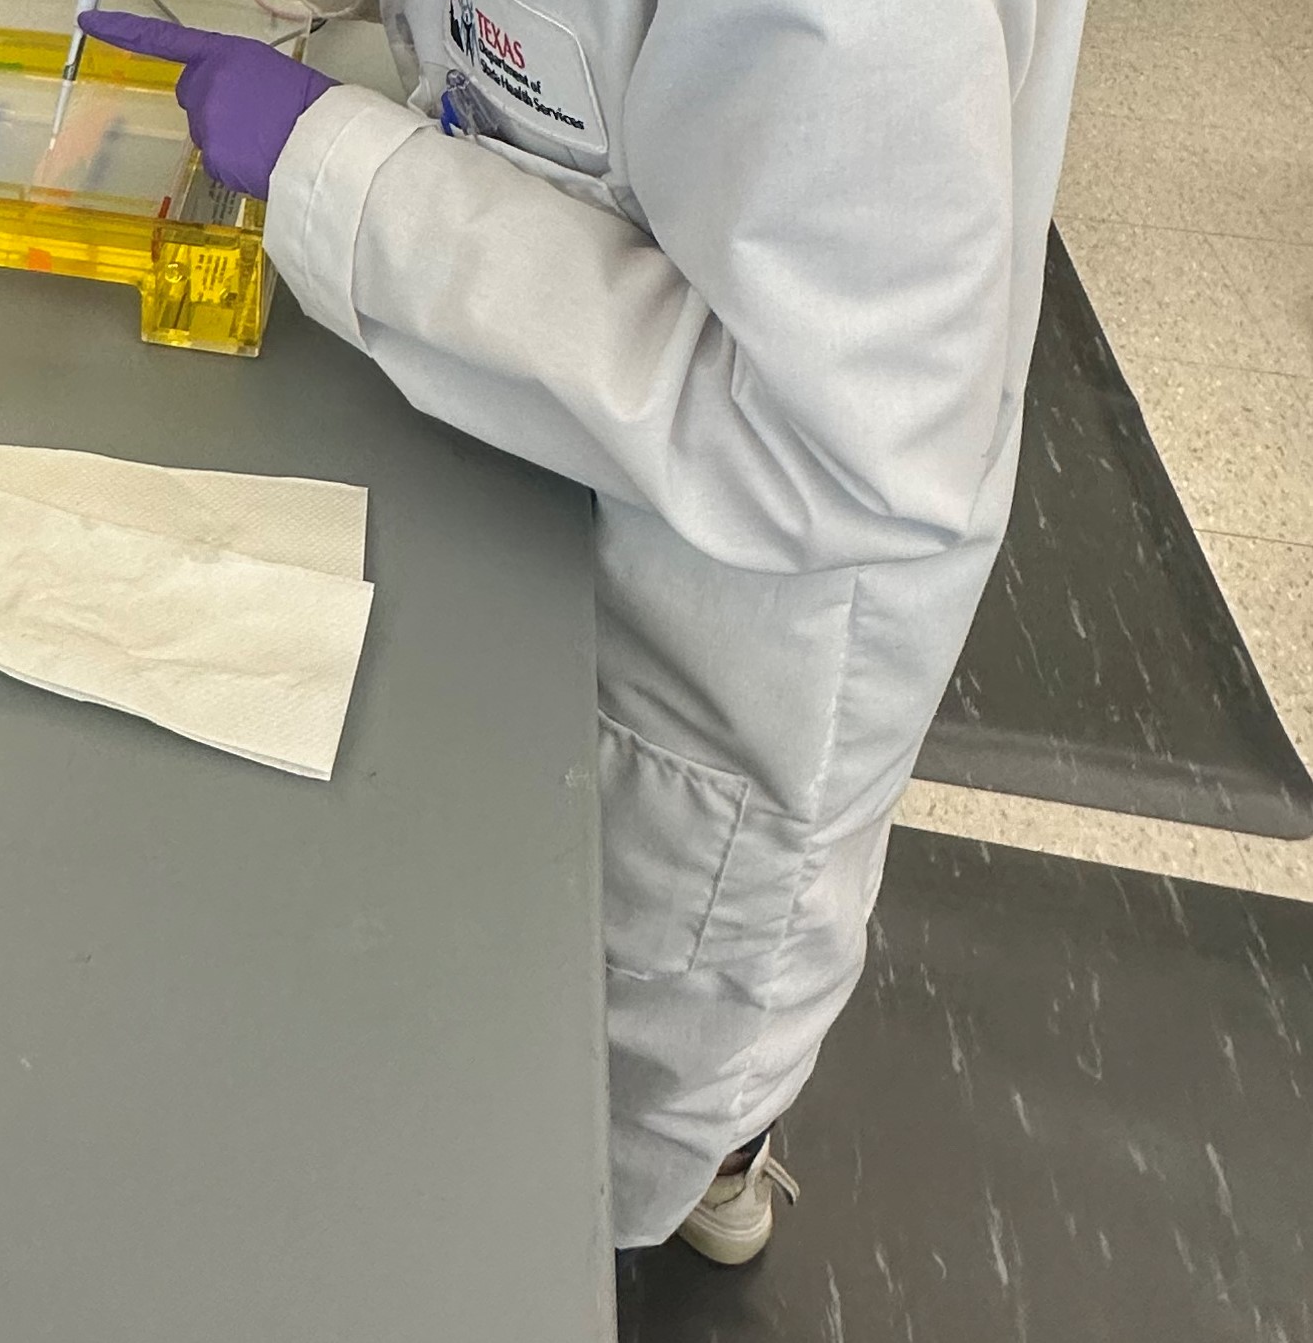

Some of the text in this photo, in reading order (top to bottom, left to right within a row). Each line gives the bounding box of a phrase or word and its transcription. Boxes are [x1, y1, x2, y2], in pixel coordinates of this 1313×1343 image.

[475, 7, 526, 70] TEXAS
[478, 37, 542, 95] Department of
[500, 74, 534, 108] Health
[533, 96, 585, 131] Services
